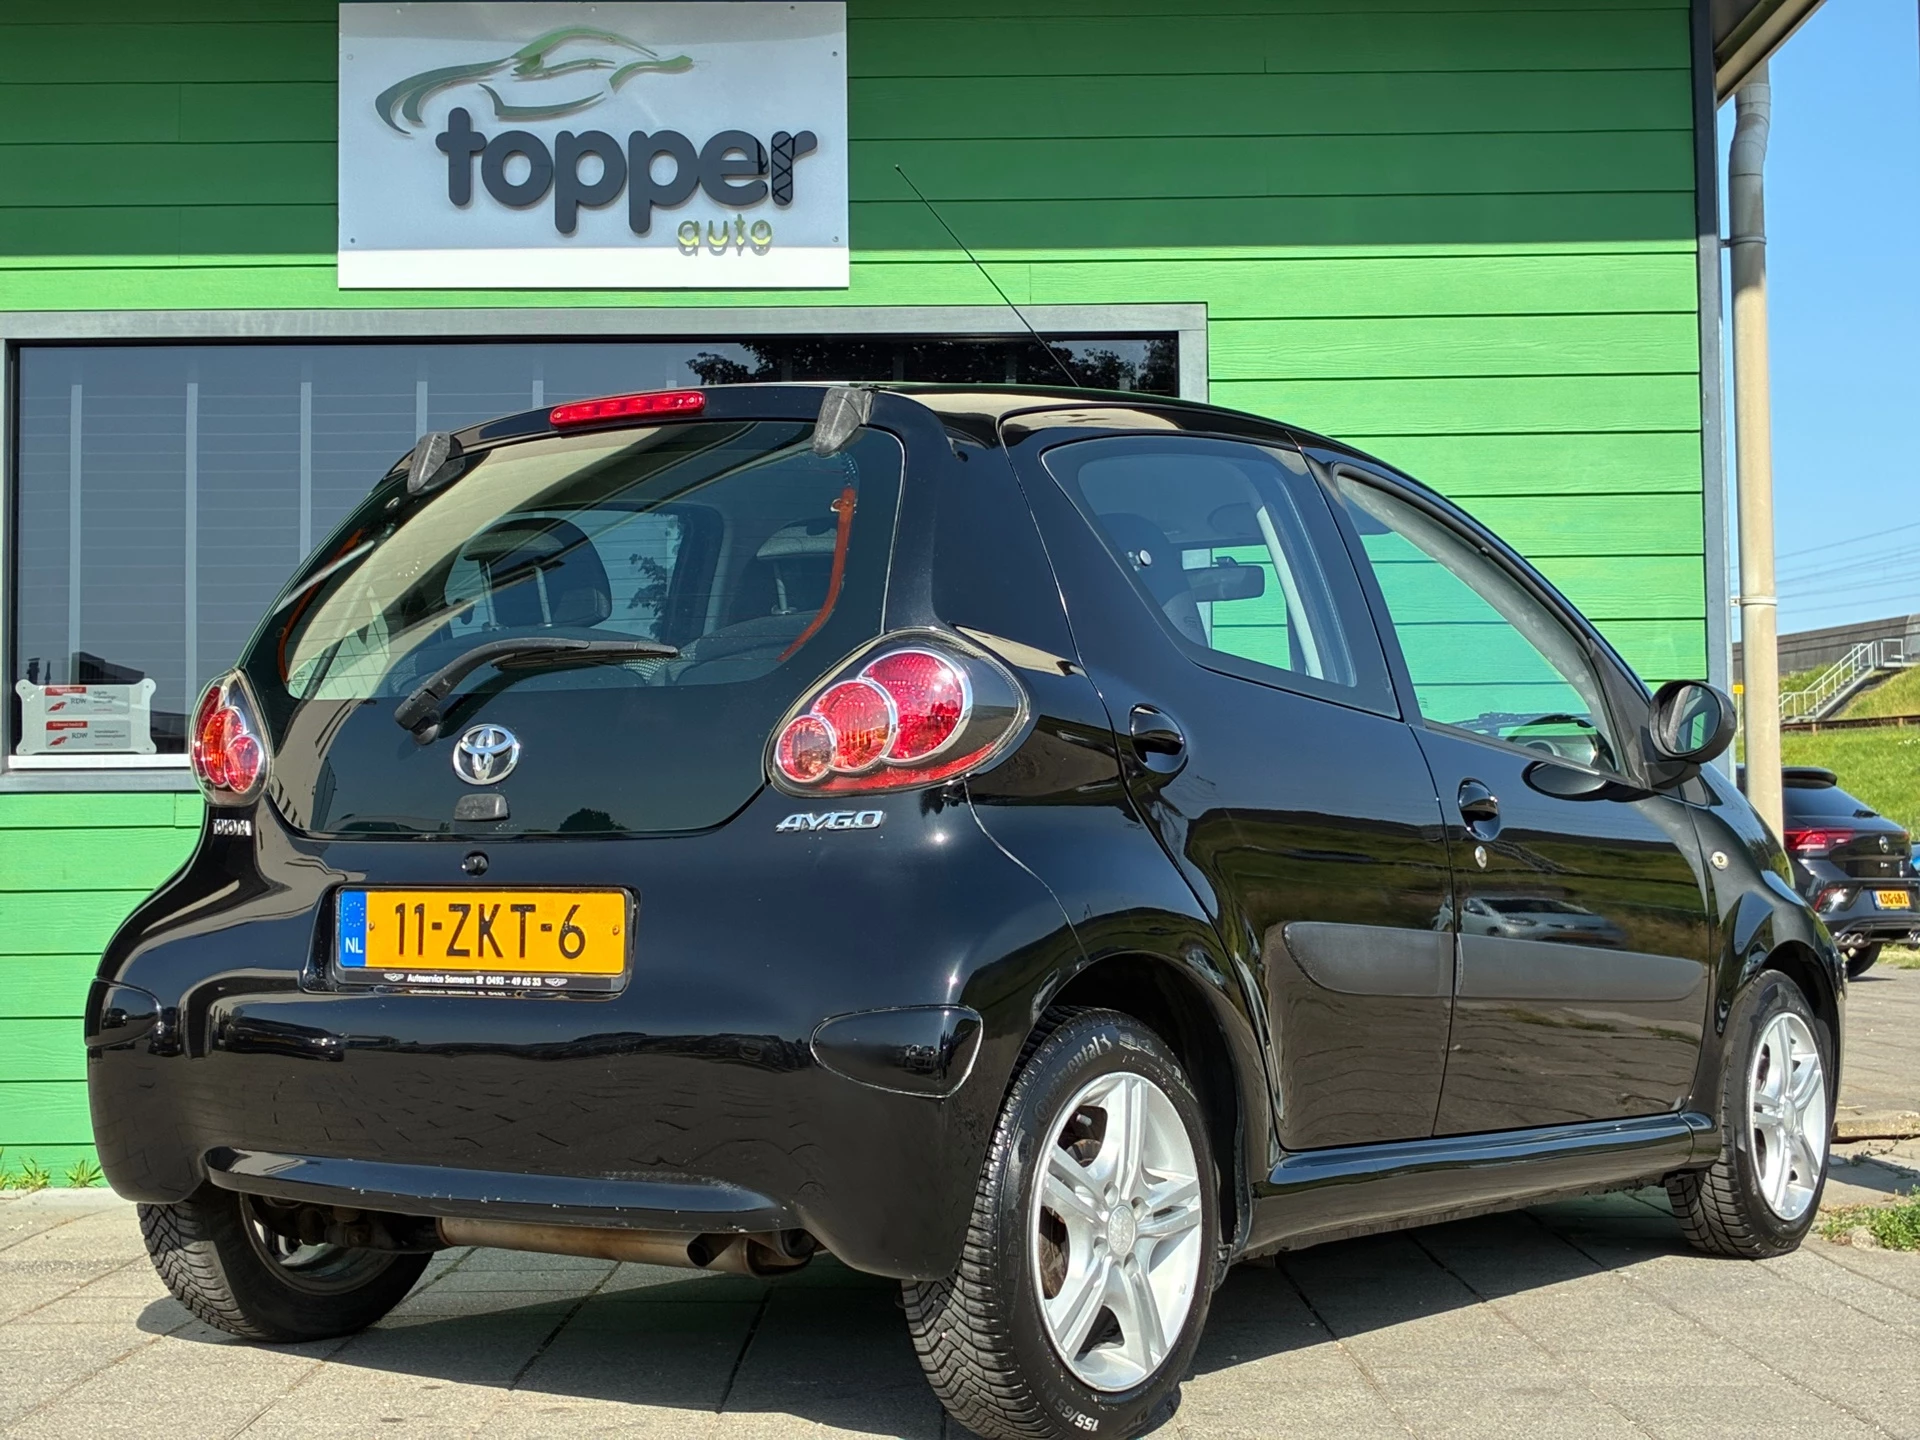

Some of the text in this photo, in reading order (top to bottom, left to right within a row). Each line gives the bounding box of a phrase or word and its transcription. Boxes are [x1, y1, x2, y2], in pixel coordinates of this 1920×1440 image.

[435, 107, 818, 234] topper
[677, 213, 773, 248] auto
[775, 810, 884, 833] AYGO
[395, 901, 586, 960] 11-ZKT-6
[345, 937, 364, 954] NL
[444, 974, 475, 984] Someren
